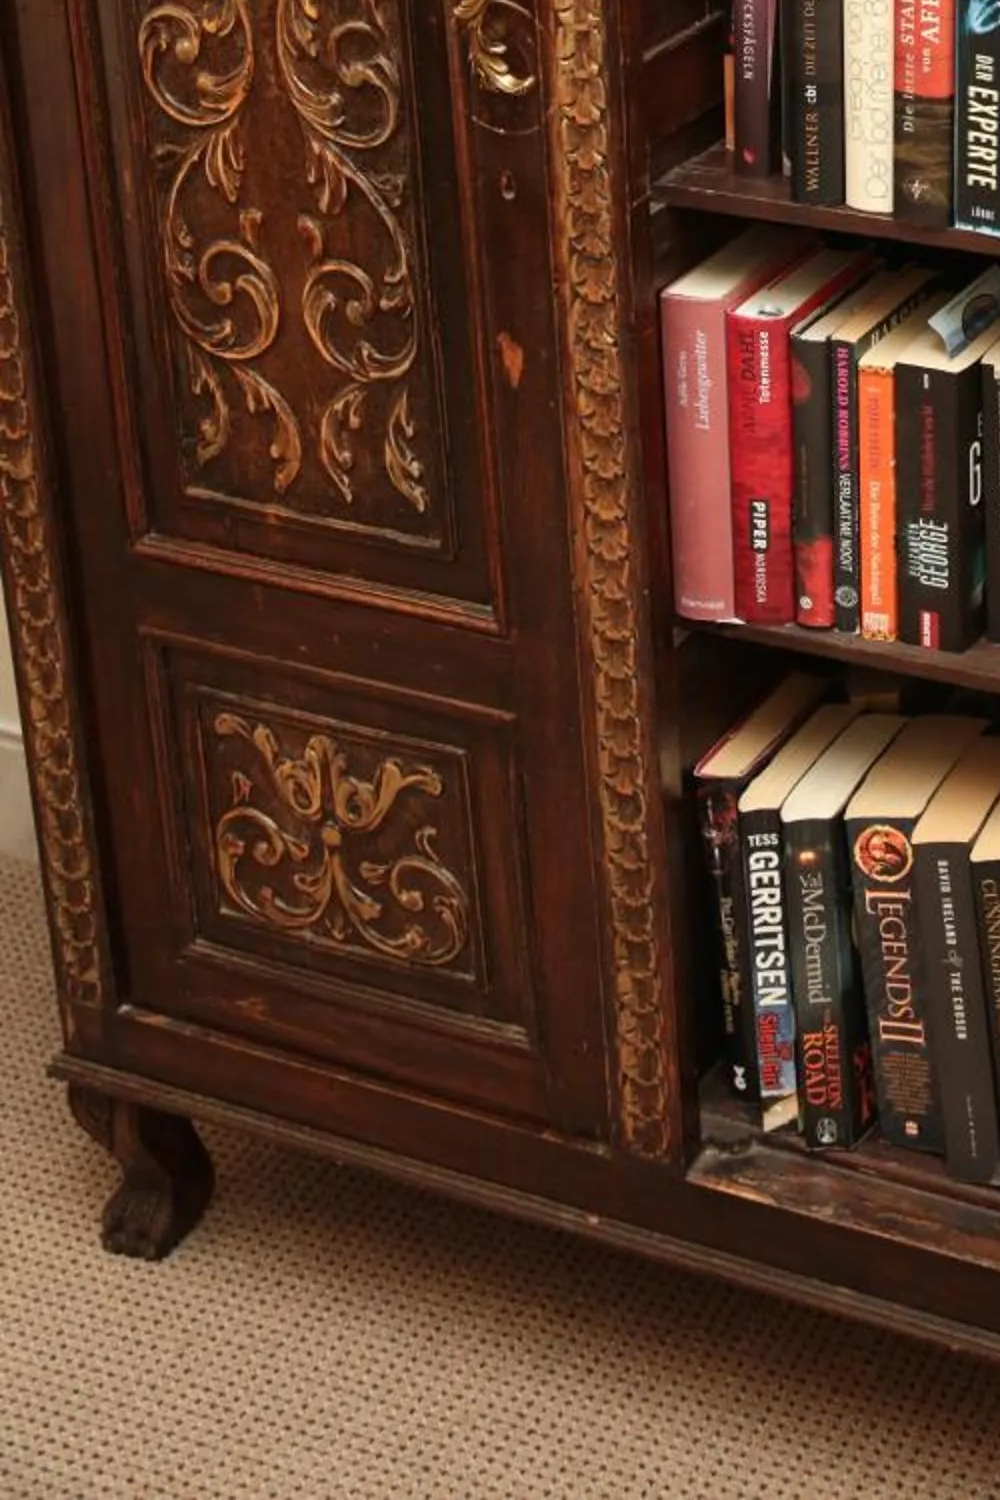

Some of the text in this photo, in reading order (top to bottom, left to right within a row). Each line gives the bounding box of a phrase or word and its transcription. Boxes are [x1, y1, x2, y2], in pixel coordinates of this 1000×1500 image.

[805, 53, 817, 76] DIE
[805, 84, 818, 104] cbt
[903, 52, 915, 106] letzte
[903, 108, 914, 133] Die
[965, 54, 999, 191] DER EXPERTE
[805, 111, 820, 192] WALLNER
[740, 329, 756, 383] DAHL
[758, 331, 769, 405] Totenmesse
[836, 346, 849, 407] HAROLD
[751, 501, 767, 549] PIPER
[838, 472, 852, 519] VERLAAT
[839, 536, 854, 573] NOOIT
[919, 518, 949, 589] GEORGE
[747, 833, 779, 848] TESS
[800, 872, 822, 888] Val
[937, 859, 957, 947] DAVID IRELAND
[749, 850, 788, 1007] GERRITSEN
[800, 887, 832, 1004] McDermid
[865, 887, 915, 1019] LEGENDS
[877, 1015, 926, 1046] II
[950, 971, 967, 1040] THE CHOSEN
[802, 1031, 827, 1106] ROAD
[822, 1024, 843, 1109] SKELETON
